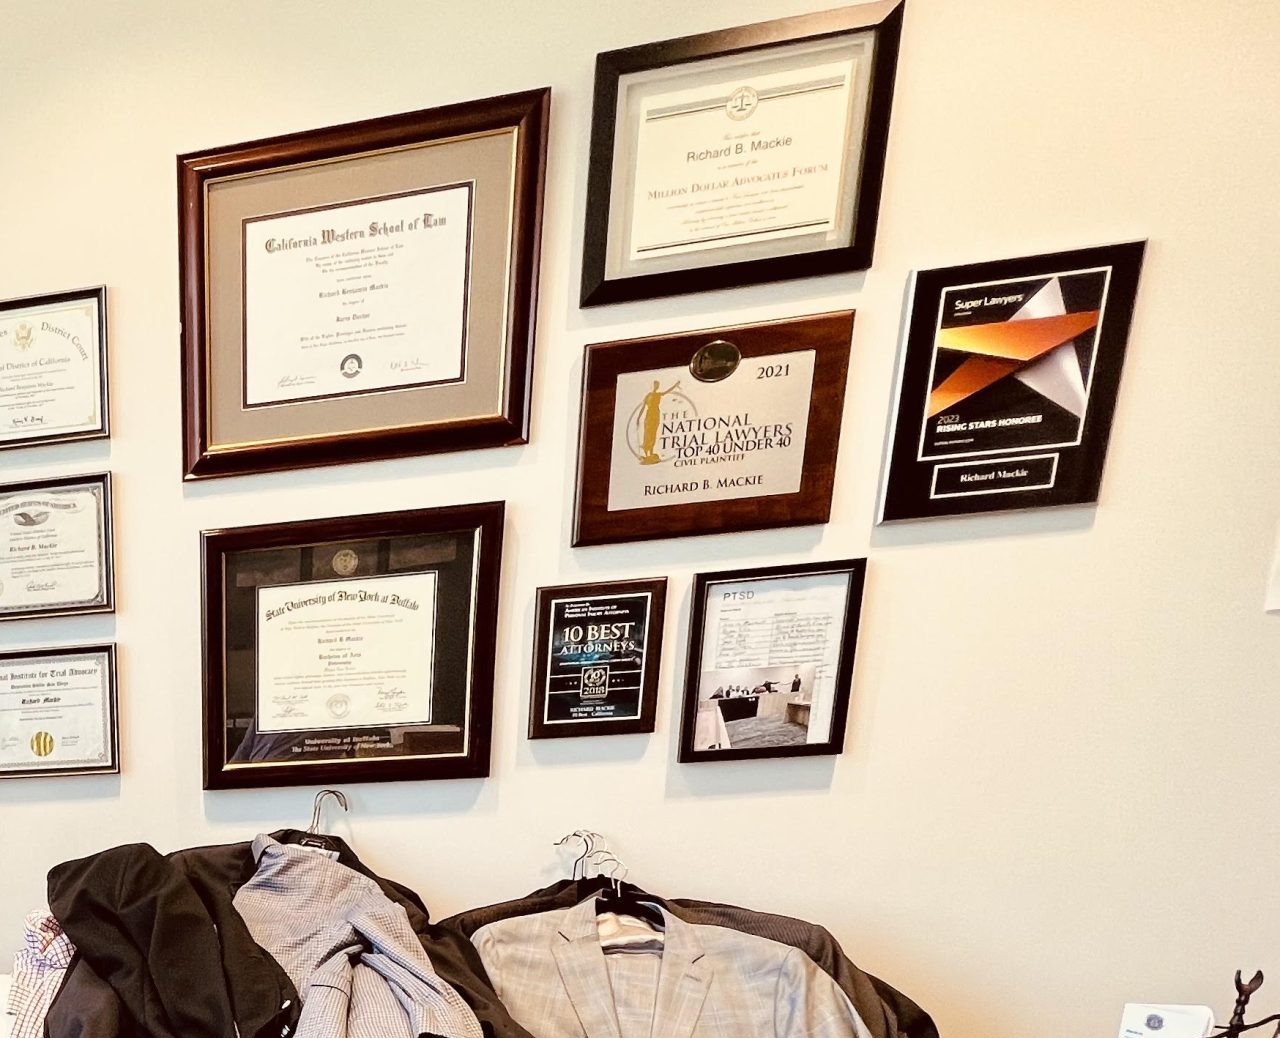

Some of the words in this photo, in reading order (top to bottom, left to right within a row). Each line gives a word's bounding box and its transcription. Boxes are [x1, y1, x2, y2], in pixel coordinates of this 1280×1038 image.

[686, 145, 731, 163] Richard
[735, 143, 746, 155] B.
[751, 136, 793, 151] Mackie
[265, 236, 318, 254] California
[321, 229, 365, 244] Western
[369, 221, 405, 238] School
[408, 217, 420, 231] of
[423, 213, 448, 229] Law
[954, 299, 984, 311] Super
[984, 293, 1024, 307] Lawyers
[41, 321, 71, 340] District
[72, 336, 89, 361] Court
[756, 364, 790, 380] 2021
[662, 411, 688, 420] THE
[662, 413, 752, 435] NATIONAL
[936, 423, 967, 433] RISING
[968, 419, 997, 430] STARS
[998, 414, 1043, 427] HONOREE
[938, 415, 960, 424] 2023
[660, 432, 708, 450] TRIAL
[715, 422, 793, 443] LAWYERS
[675, 446, 703, 459] TOP
[705, 444, 720, 456] 40
[723, 438, 773, 454] UNDER
[776, 435, 791, 448] 40
[674, 459, 698, 467] CIVIL
[701, 453, 745, 464] PLAINTIFF
[644, 481, 699, 496] RICHARD
[703, 479, 713, 490] B.
[716, 475, 763, 489] MACKIE
[960, 471, 995, 483] Richard
[723, 590, 755, 601] PTSD
[265, 607, 285, 622] State
[284, 594, 328, 612] University
[327, 591, 336, 603] of
[337, 590, 358, 602] New
[358, 589, 380, 603] York
[380, 594, 389, 603] at
[389, 594, 420, 611] Buffalo
[563, 626, 584, 642] 10
[587, 622, 635, 641] BEST
[560, 640, 635, 655] ATTORNEYS
[583, 686, 605, 695] 2018
